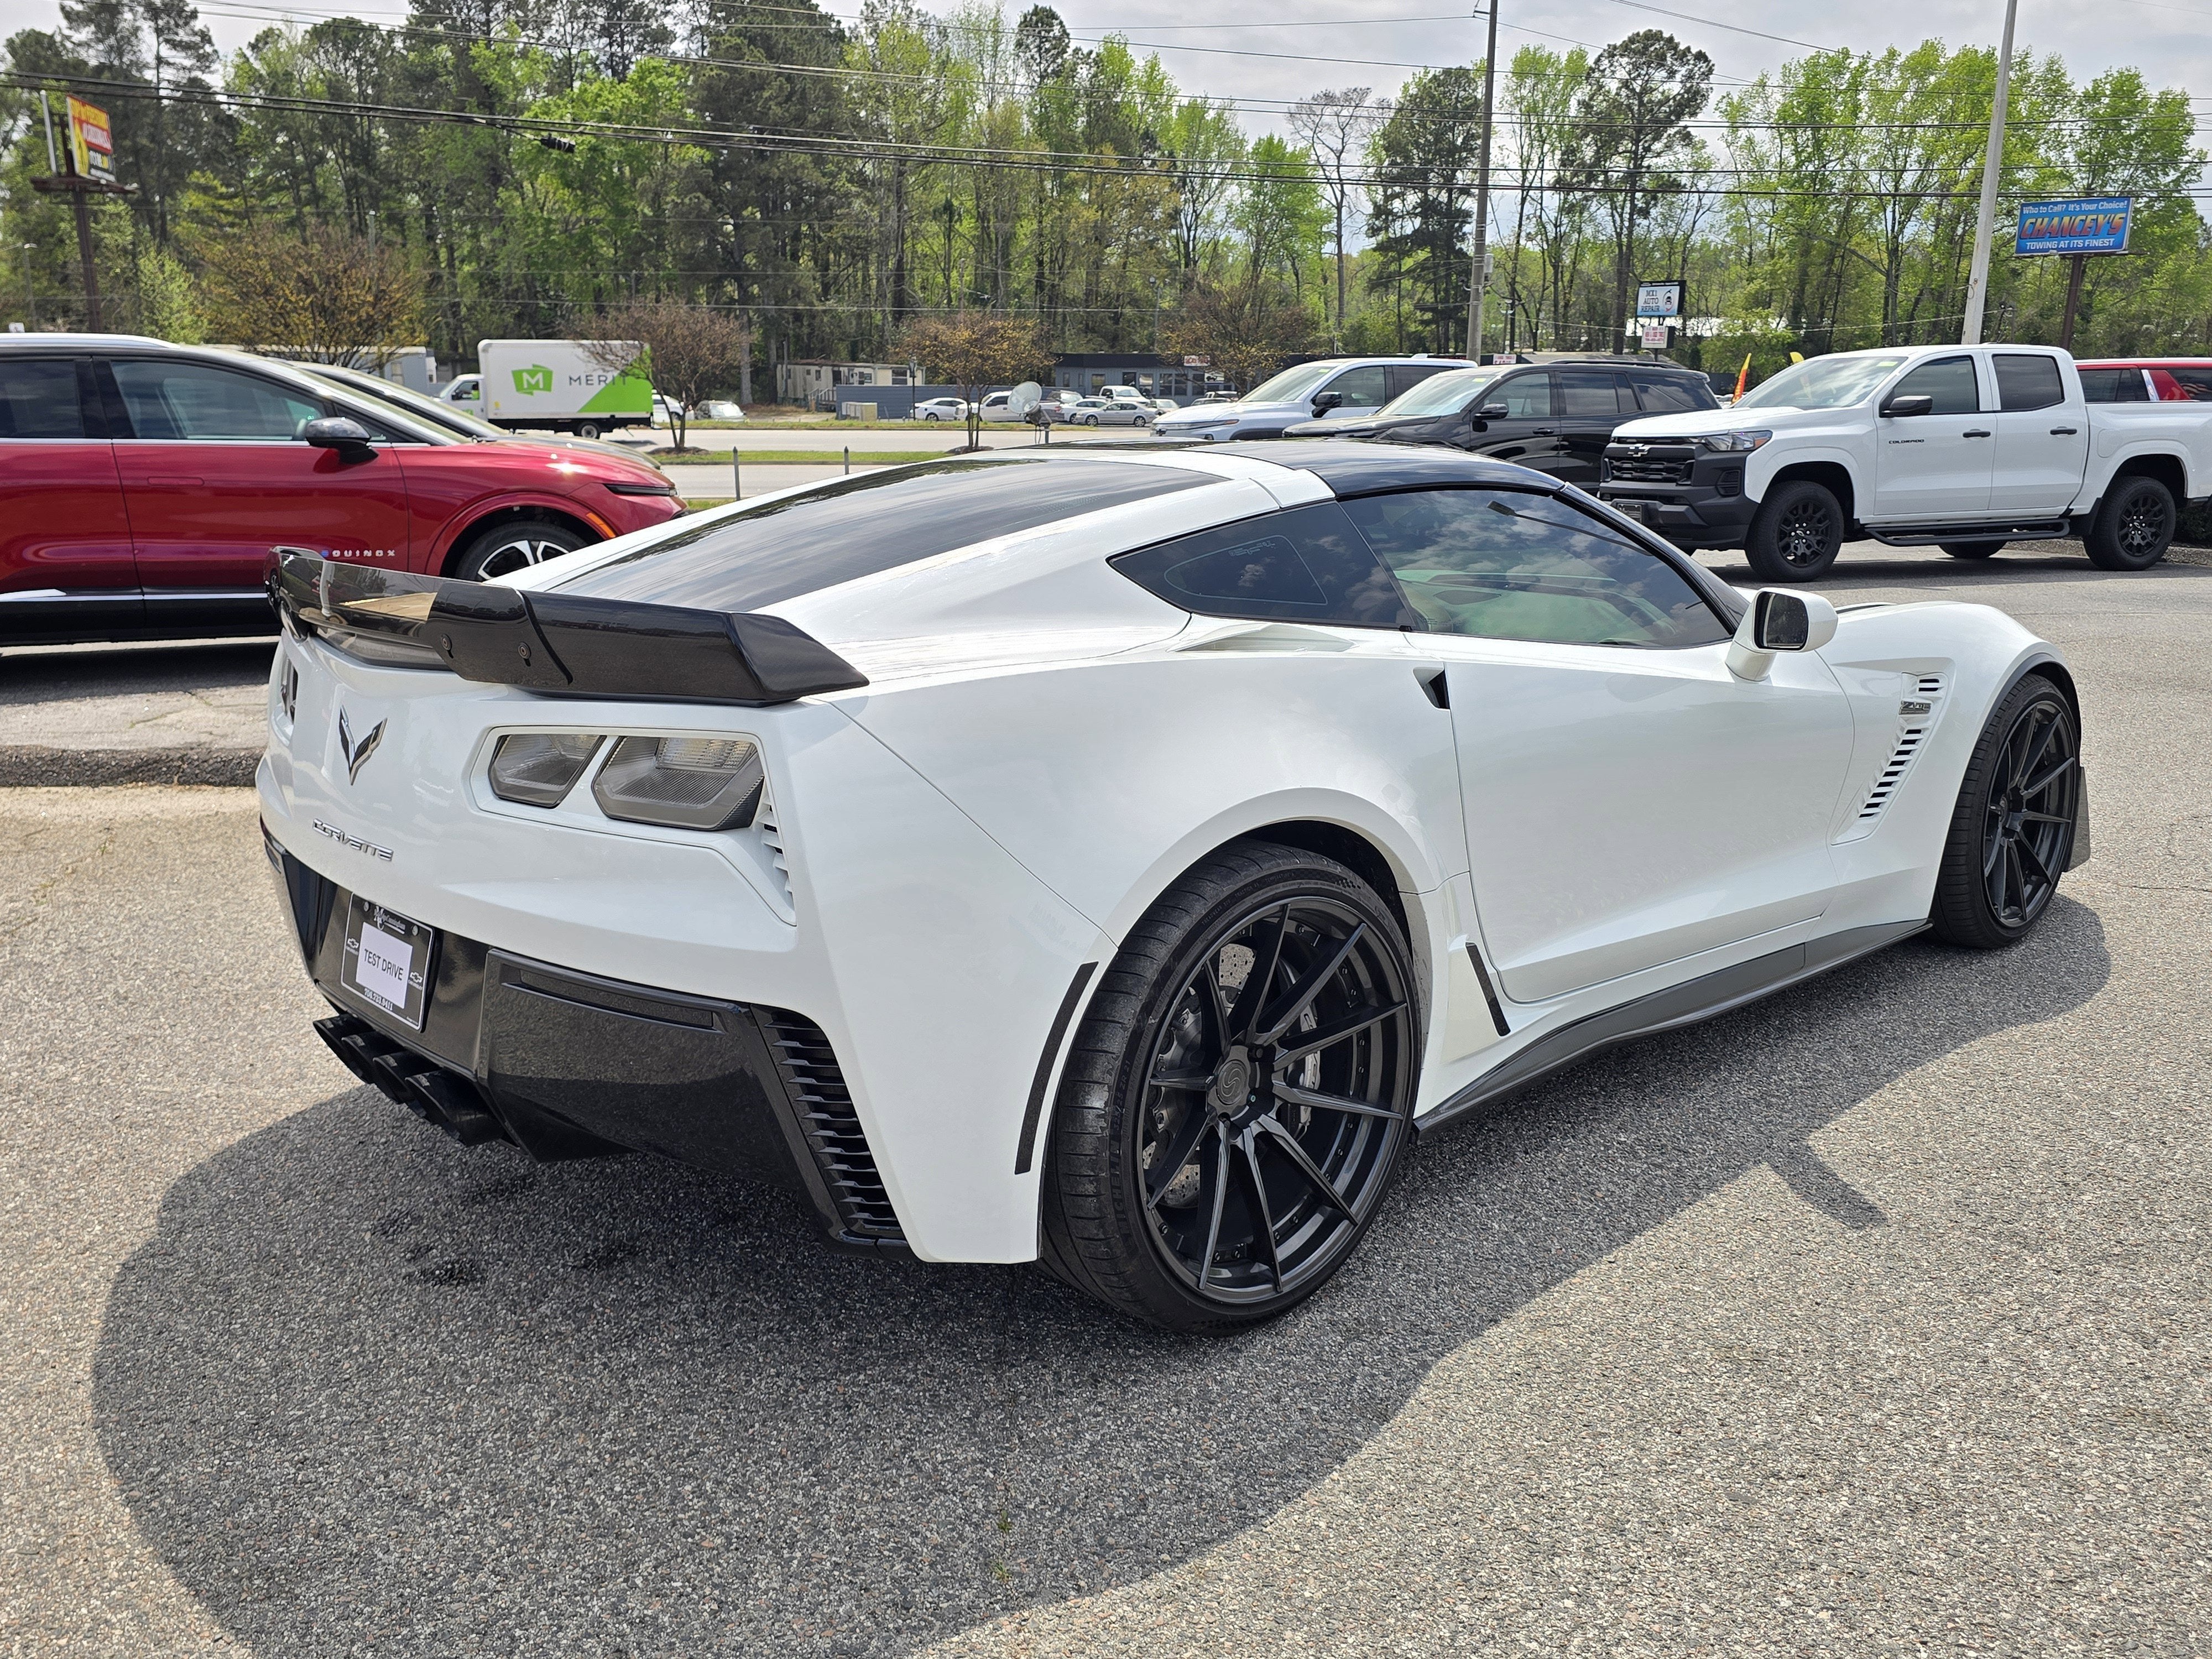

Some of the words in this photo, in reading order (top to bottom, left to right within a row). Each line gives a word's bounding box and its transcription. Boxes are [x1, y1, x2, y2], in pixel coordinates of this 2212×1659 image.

[2048, 204, 2066, 212] Call?
[2068, 203, 2080, 211] It's
[2099, 201, 2127, 210] Choice!
[2020, 213, 2126, 239] CHANCEY'S
[2026, 241, 2057, 249] TOWING
[2070, 239, 2083, 247] ITS
[2085, 238, 2115, 247] FINEST
[523, 372, 544, 388] M
[568, 374, 627, 386] MERIT
[320, 549, 396, 557] EQUINOX
[312, 818, 394, 862] CORVETTE
[364, 948, 382, 969] TEST
[382, 958, 404, 981] DRIVE
[1123, 1060, 1131, 1072] 21
[1119, 1074, 1129, 1089] ZR
[1110, 1140, 1130, 1235] MICHELIN
